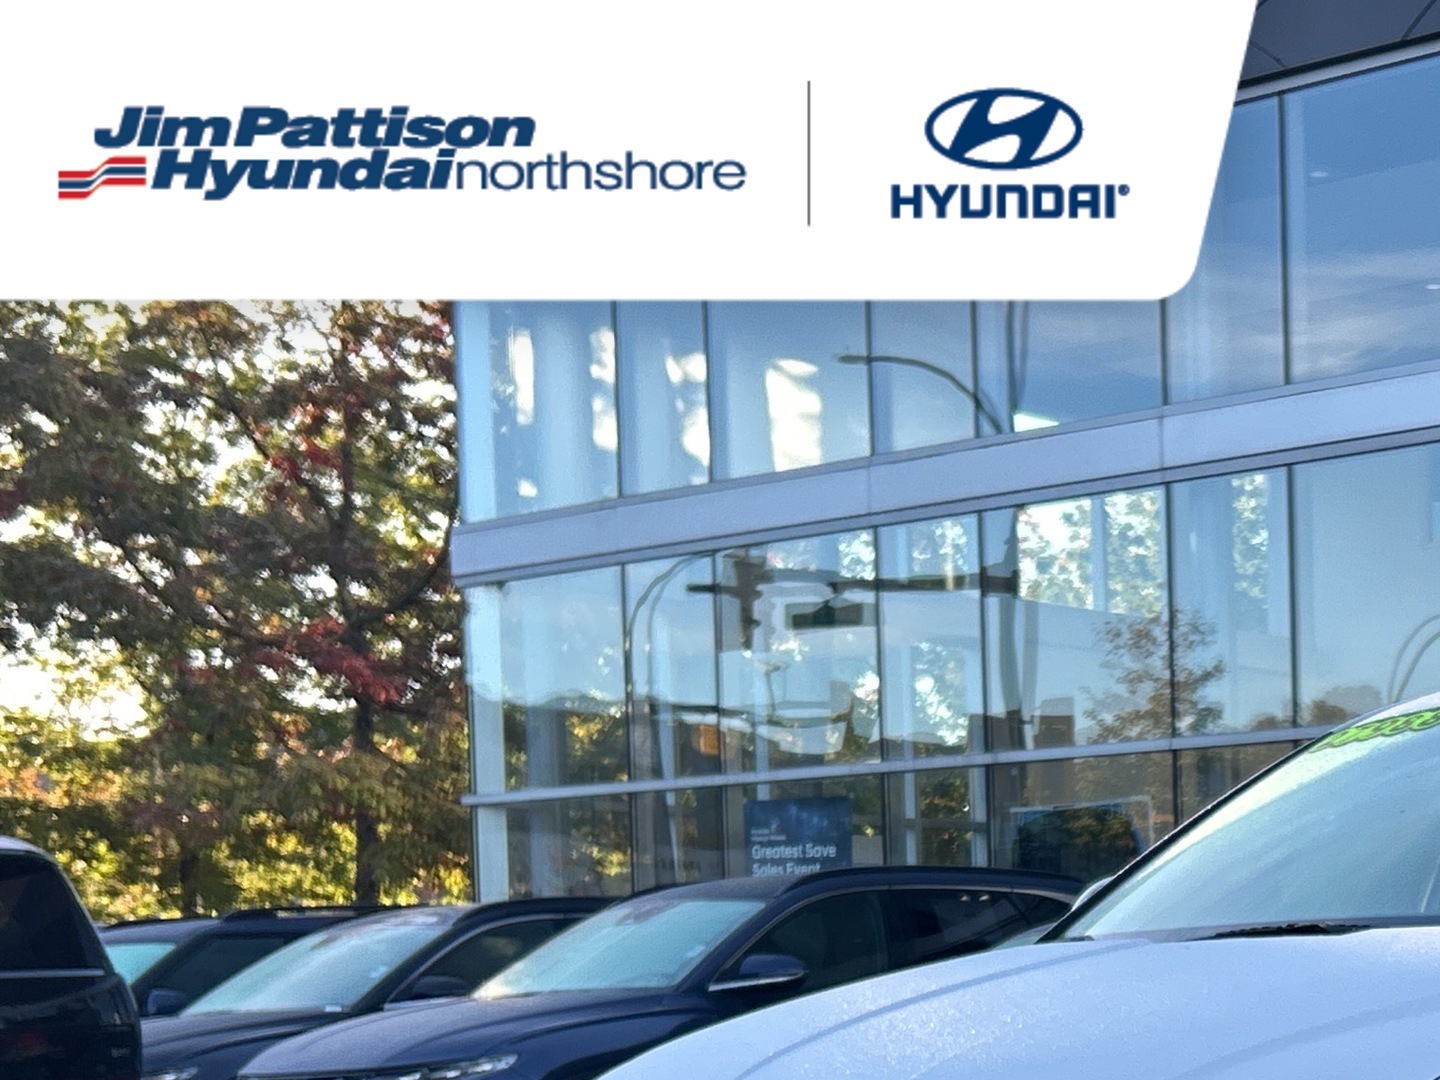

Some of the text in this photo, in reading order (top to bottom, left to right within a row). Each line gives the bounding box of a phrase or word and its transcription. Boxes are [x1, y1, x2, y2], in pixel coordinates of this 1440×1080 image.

[751, 842, 837, 860] Greatest Save
[751, 862, 785, 877] Sales
